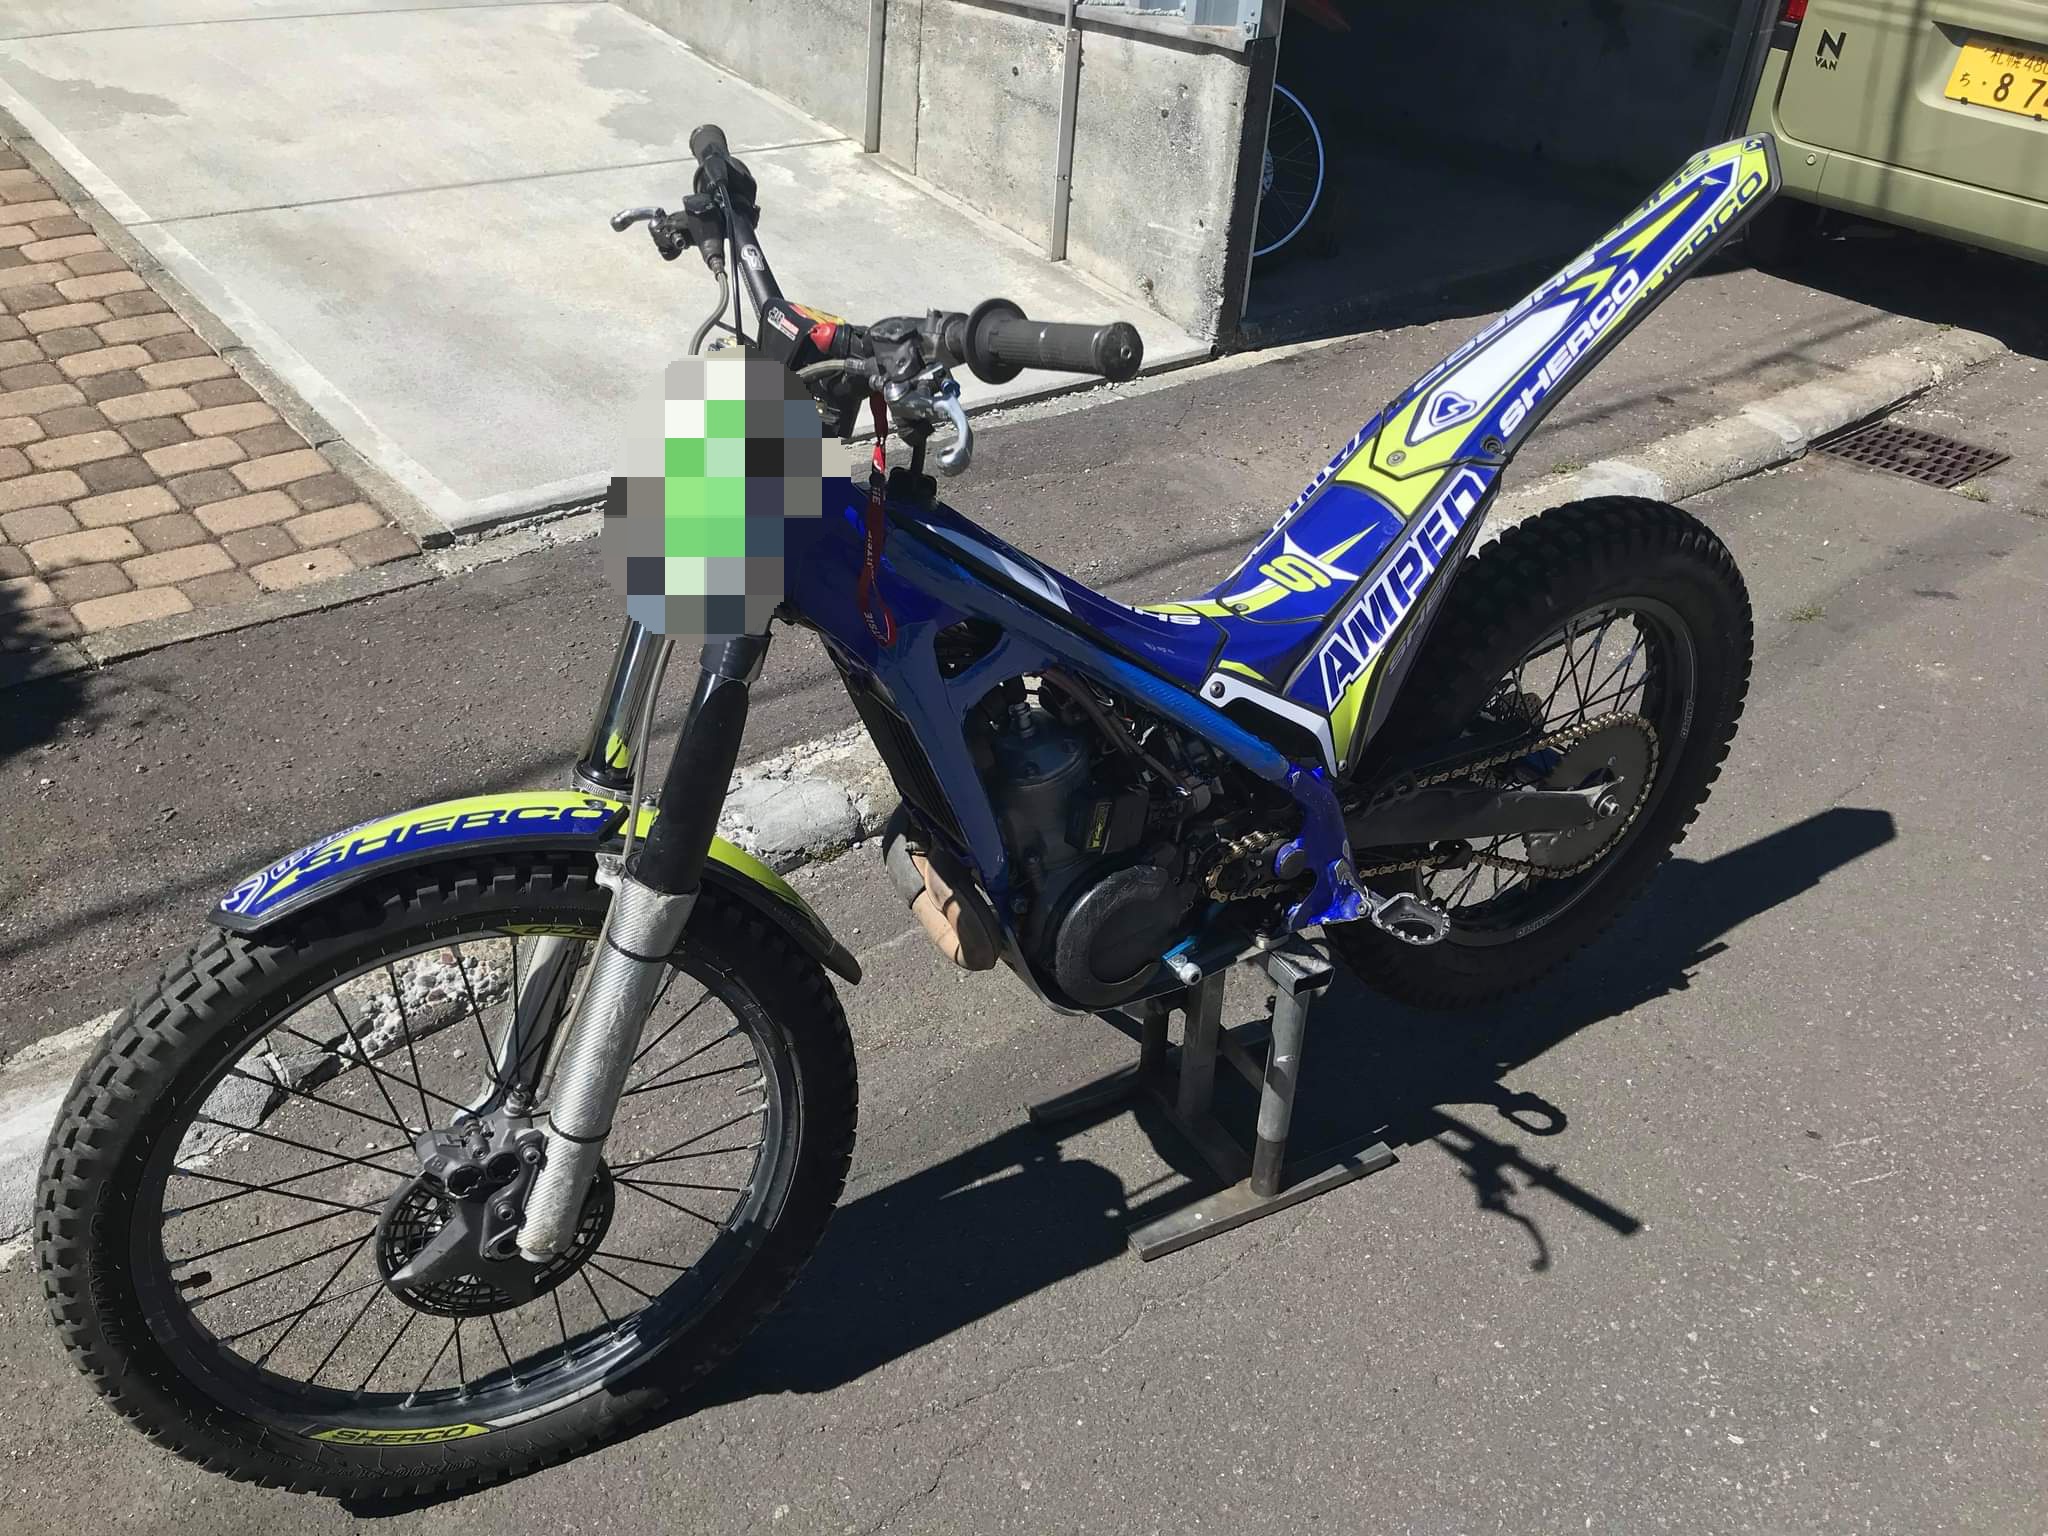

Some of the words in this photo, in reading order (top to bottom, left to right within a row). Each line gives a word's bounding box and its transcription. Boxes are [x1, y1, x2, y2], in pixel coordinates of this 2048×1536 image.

[1815, 55, 1838, 72] VAN
[1817, 29, 1847, 60] N
[1498, 269, 1640, 437] SHERCO
[1318, 467, 1488, 714] AMPED
[297, 805, 619, 874] SHERCO
[331, 1426, 468, 1444] SHERCO
